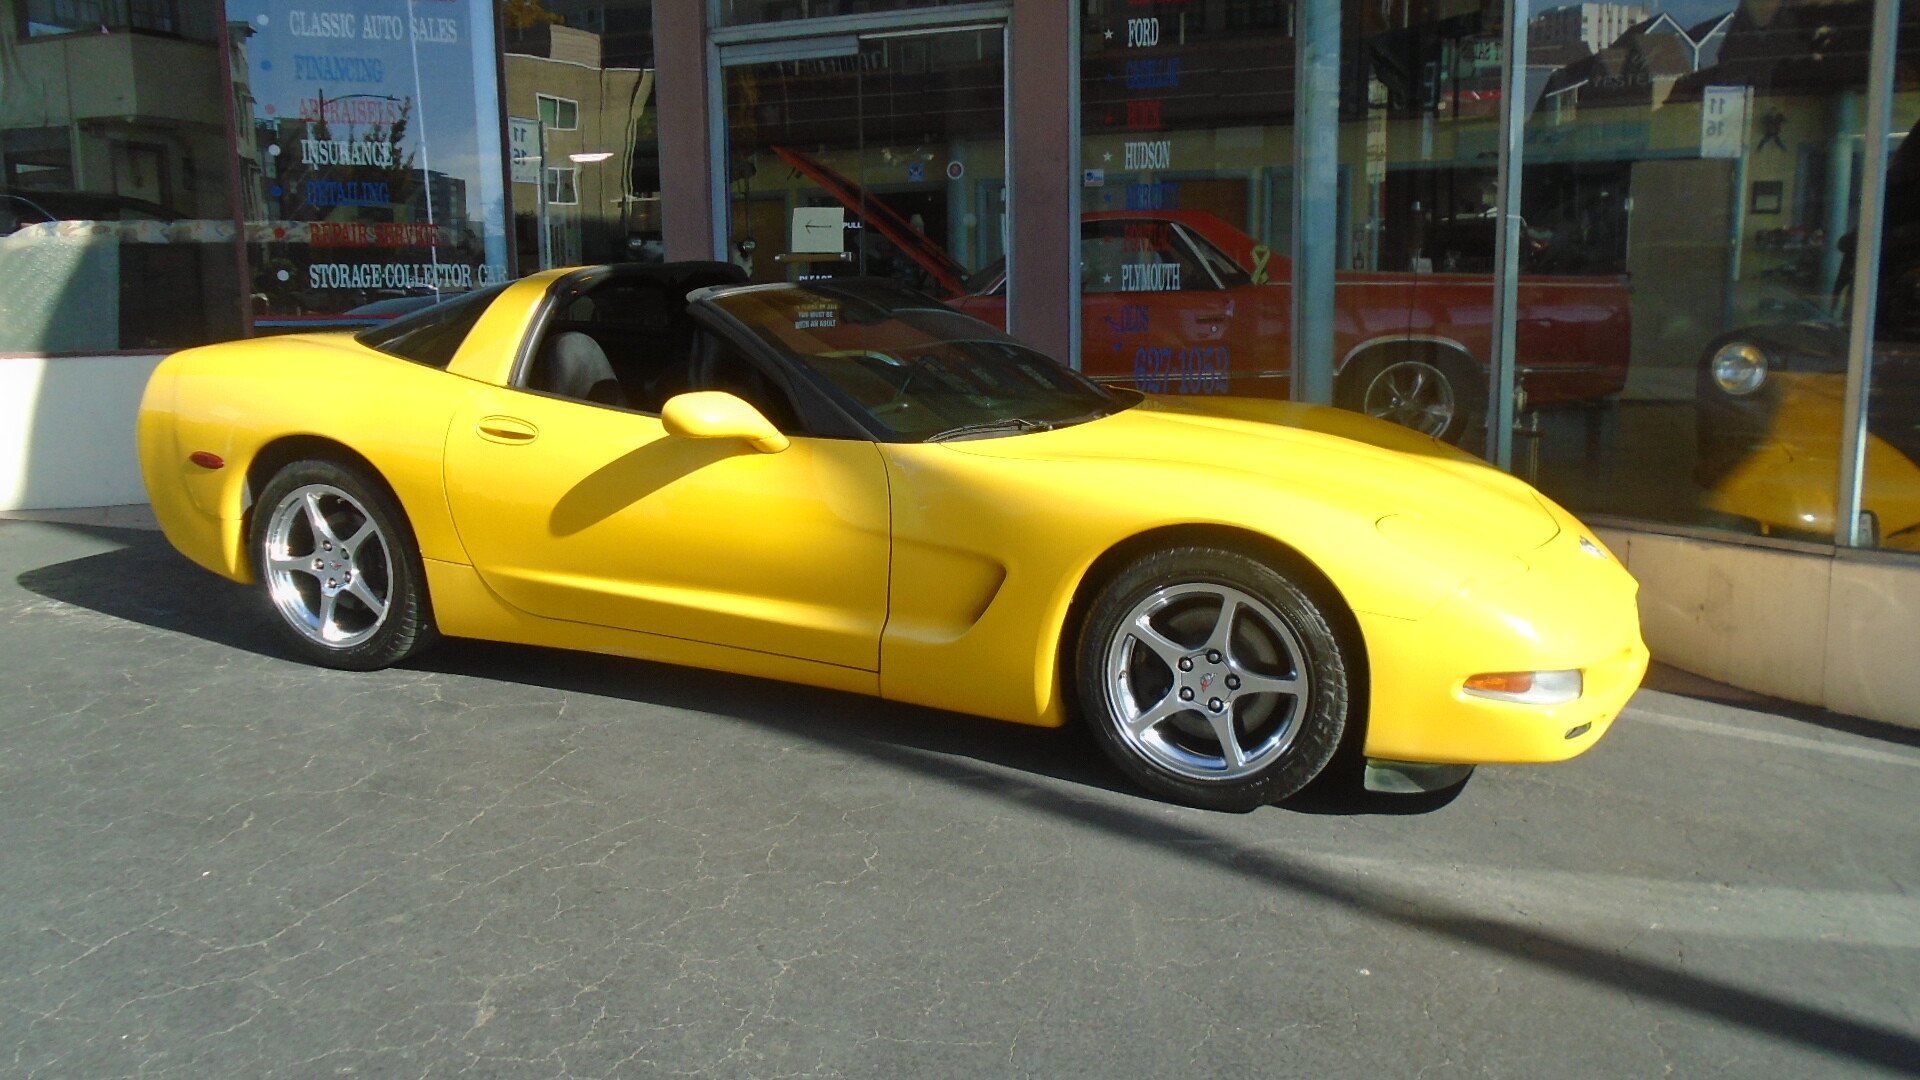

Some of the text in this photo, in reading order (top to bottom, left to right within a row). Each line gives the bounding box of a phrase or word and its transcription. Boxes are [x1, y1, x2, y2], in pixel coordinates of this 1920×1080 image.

[289, 10, 457, 43] CLASSIC AUTO SALES
[1127, 17, 1159, 47] FORD
[294, 54, 385, 83] FINANCING
[300, 139, 393, 167] INSURANCE
[1124, 140, 1171, 170] HUDSON
[1121, 262, 1181, 291] PLYMOUTH
